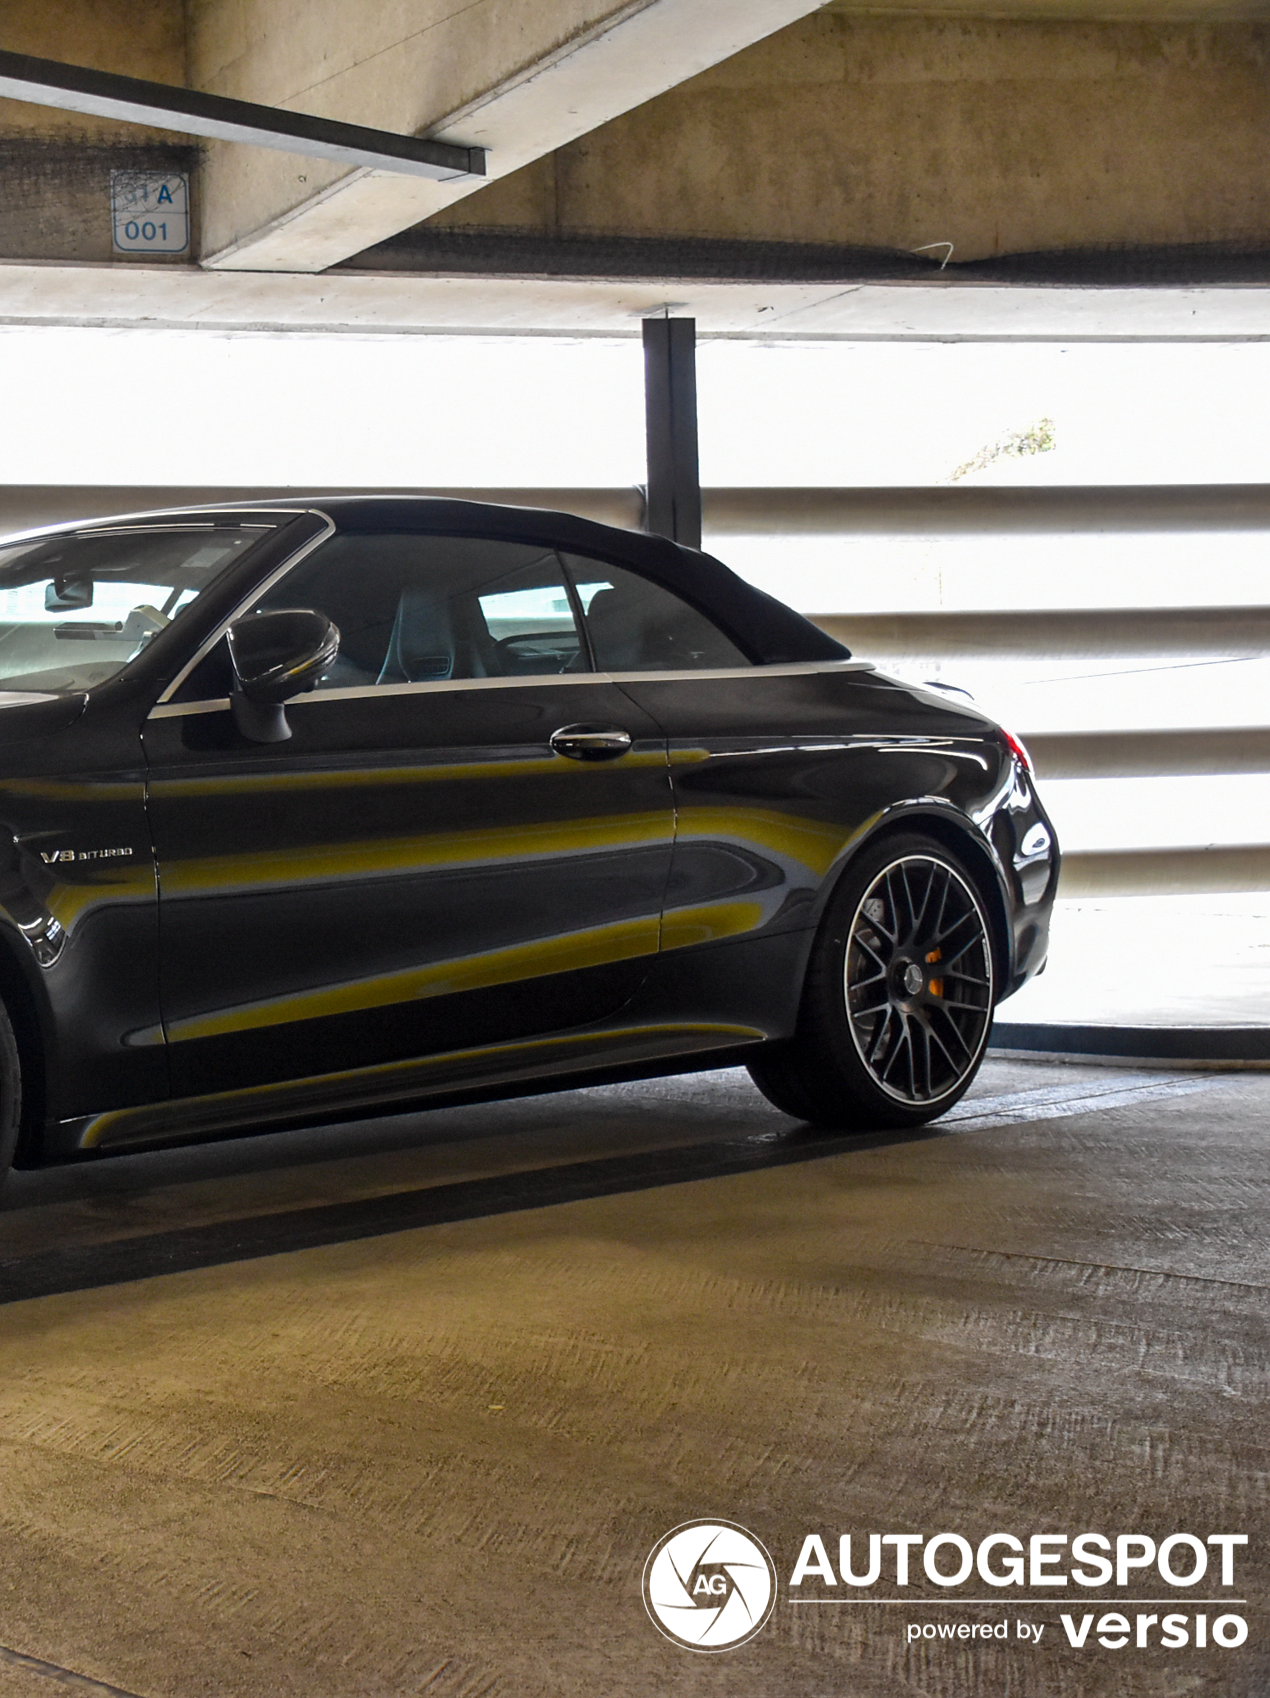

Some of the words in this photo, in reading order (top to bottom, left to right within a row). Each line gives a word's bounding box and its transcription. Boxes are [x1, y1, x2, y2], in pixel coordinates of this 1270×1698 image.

[125, 221, 168, 241] 001
[40, 850, 75, 864] V8
[79, 847, 133, 861] BITURBO
